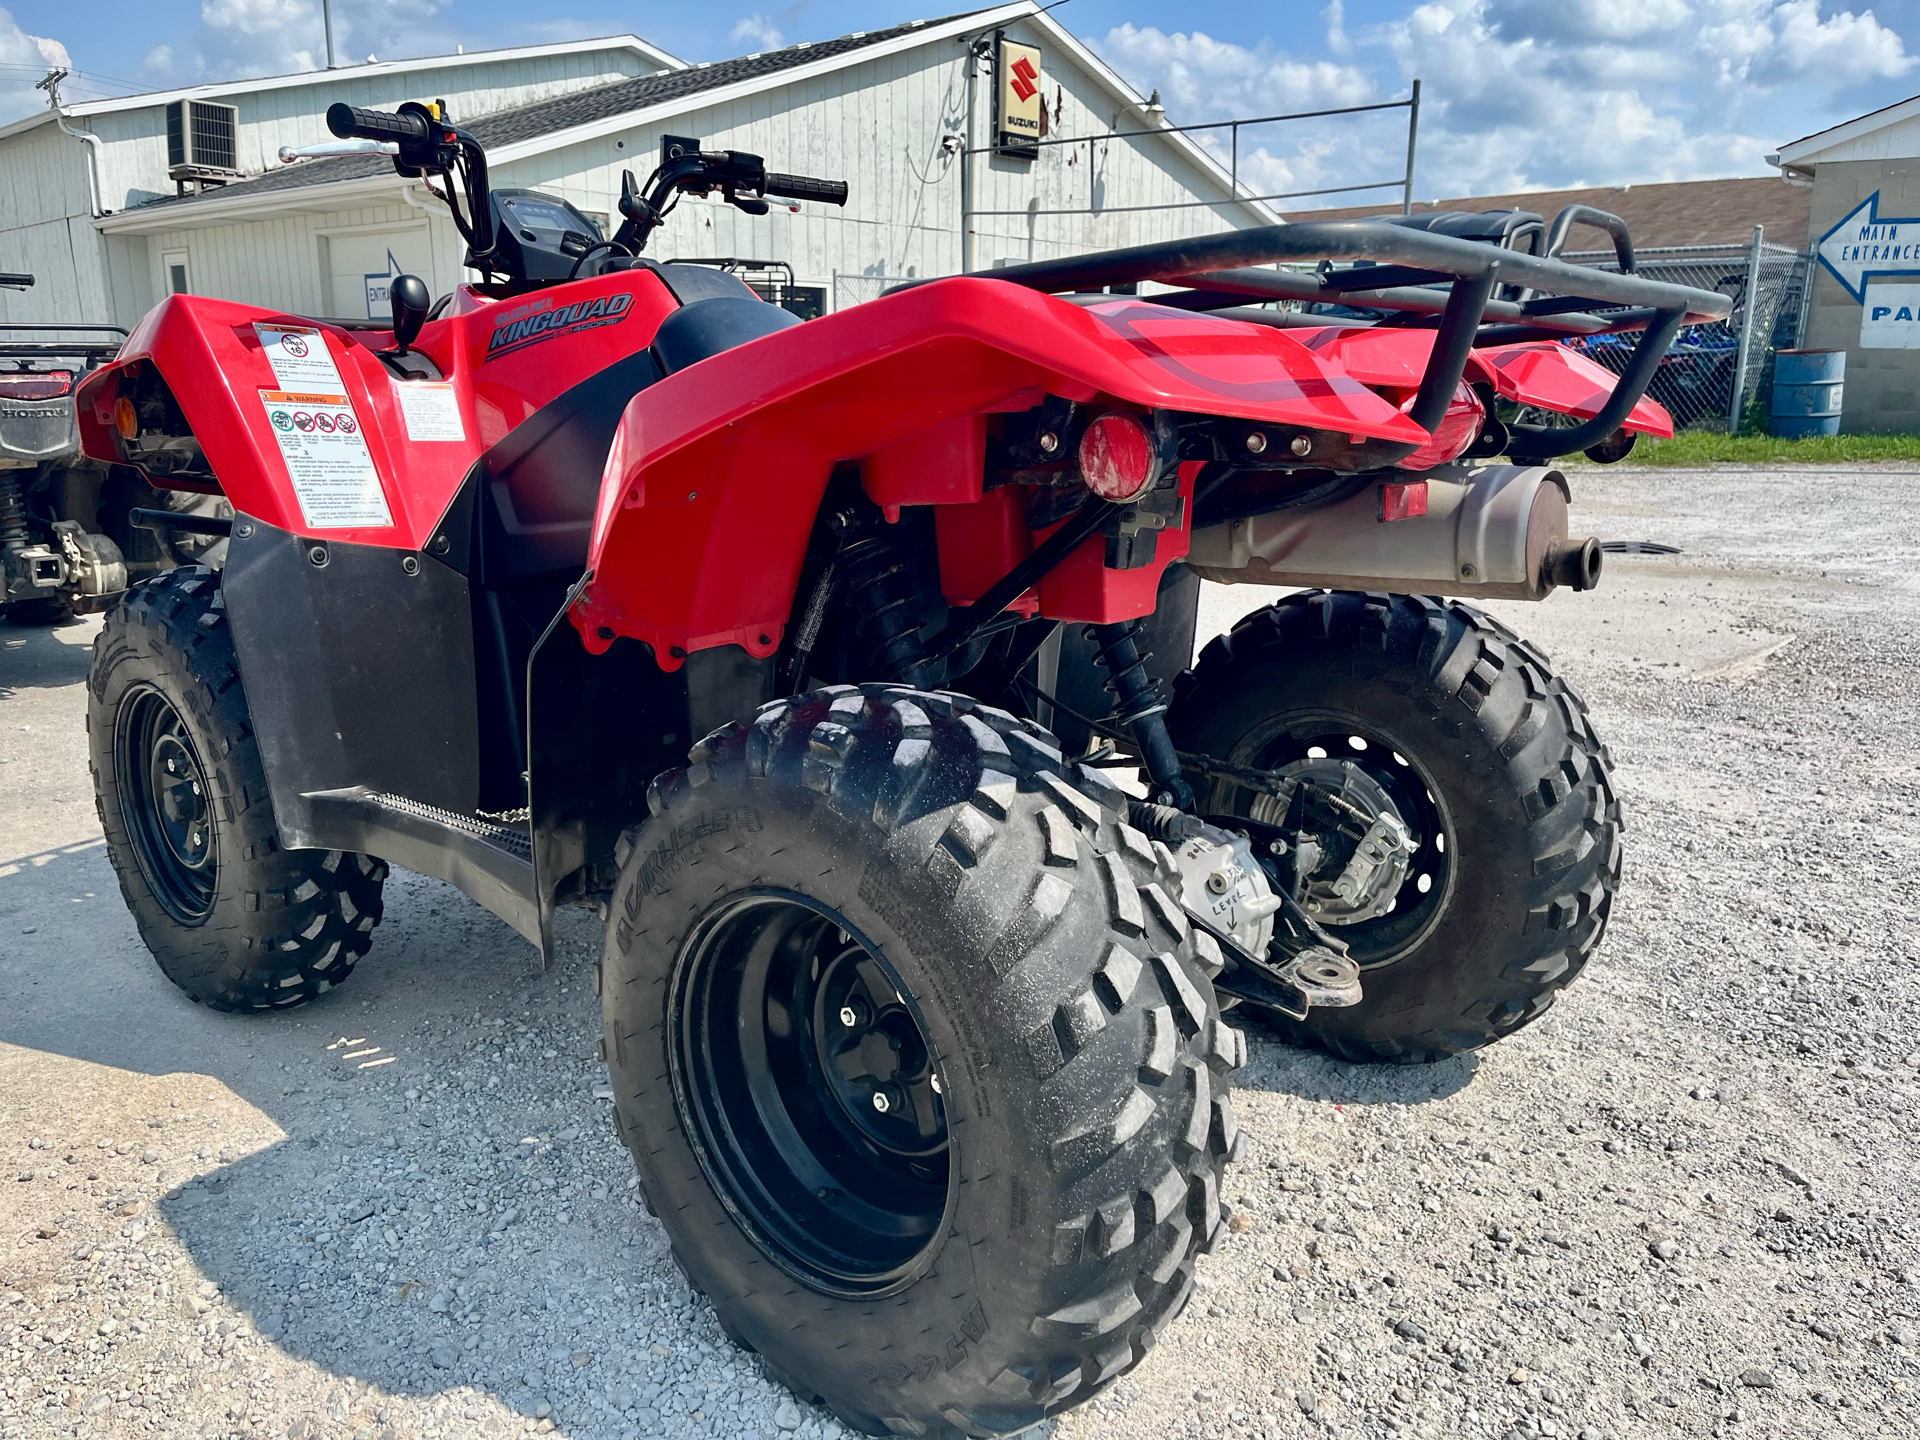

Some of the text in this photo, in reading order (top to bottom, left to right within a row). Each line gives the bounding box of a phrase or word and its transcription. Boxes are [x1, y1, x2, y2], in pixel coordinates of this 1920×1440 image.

[1008, 116, 1038, 129] SUZUKI
[1859, 224, 1898, 241] MAIN
[1842, 244, 1920, 261] ENTRANCE
[494, 297, 553, 326] SUZUKI
[1872, 306, 1920, 321] PA
[486, 292, 634, 353] KINGQUAD
[291, 346, 302, 354] 16
[2, 408, 67, 418] HONDA
[624, 804, 731, 922] CARLISLE
[1212, 888, 1246, 916] LEVEL
